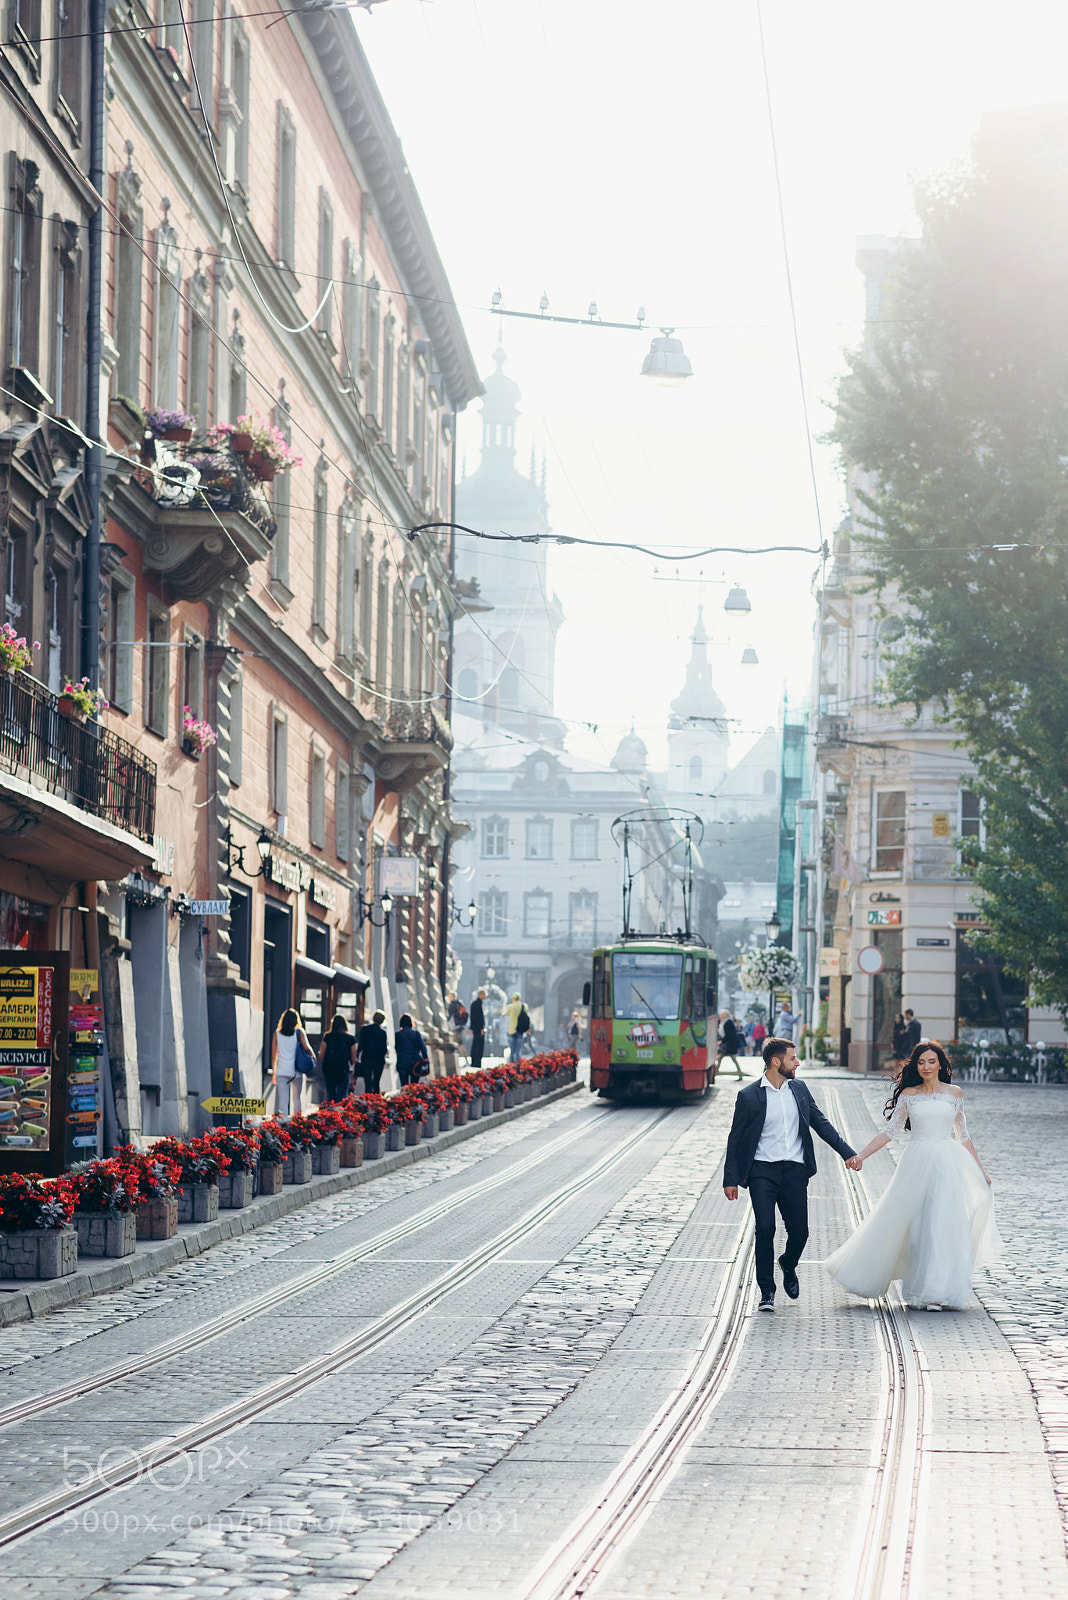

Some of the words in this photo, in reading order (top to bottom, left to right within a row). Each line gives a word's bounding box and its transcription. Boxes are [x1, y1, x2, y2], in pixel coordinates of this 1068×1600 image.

[191, 901, 228, 913] СУВЛАКІ
[0, 1004, 37, 1014] АМЕРИ
[43, 970, 53, 1044] EXCHANGE
[0, 1015, 36, 1023] БЕРІГАННЯ
[18, 1028, 36, 1039] 22.00
[0, 1051, 47, 1064] КСКУРСІЇ
[220, 1098, 265, 1108] КАМЕРИ
